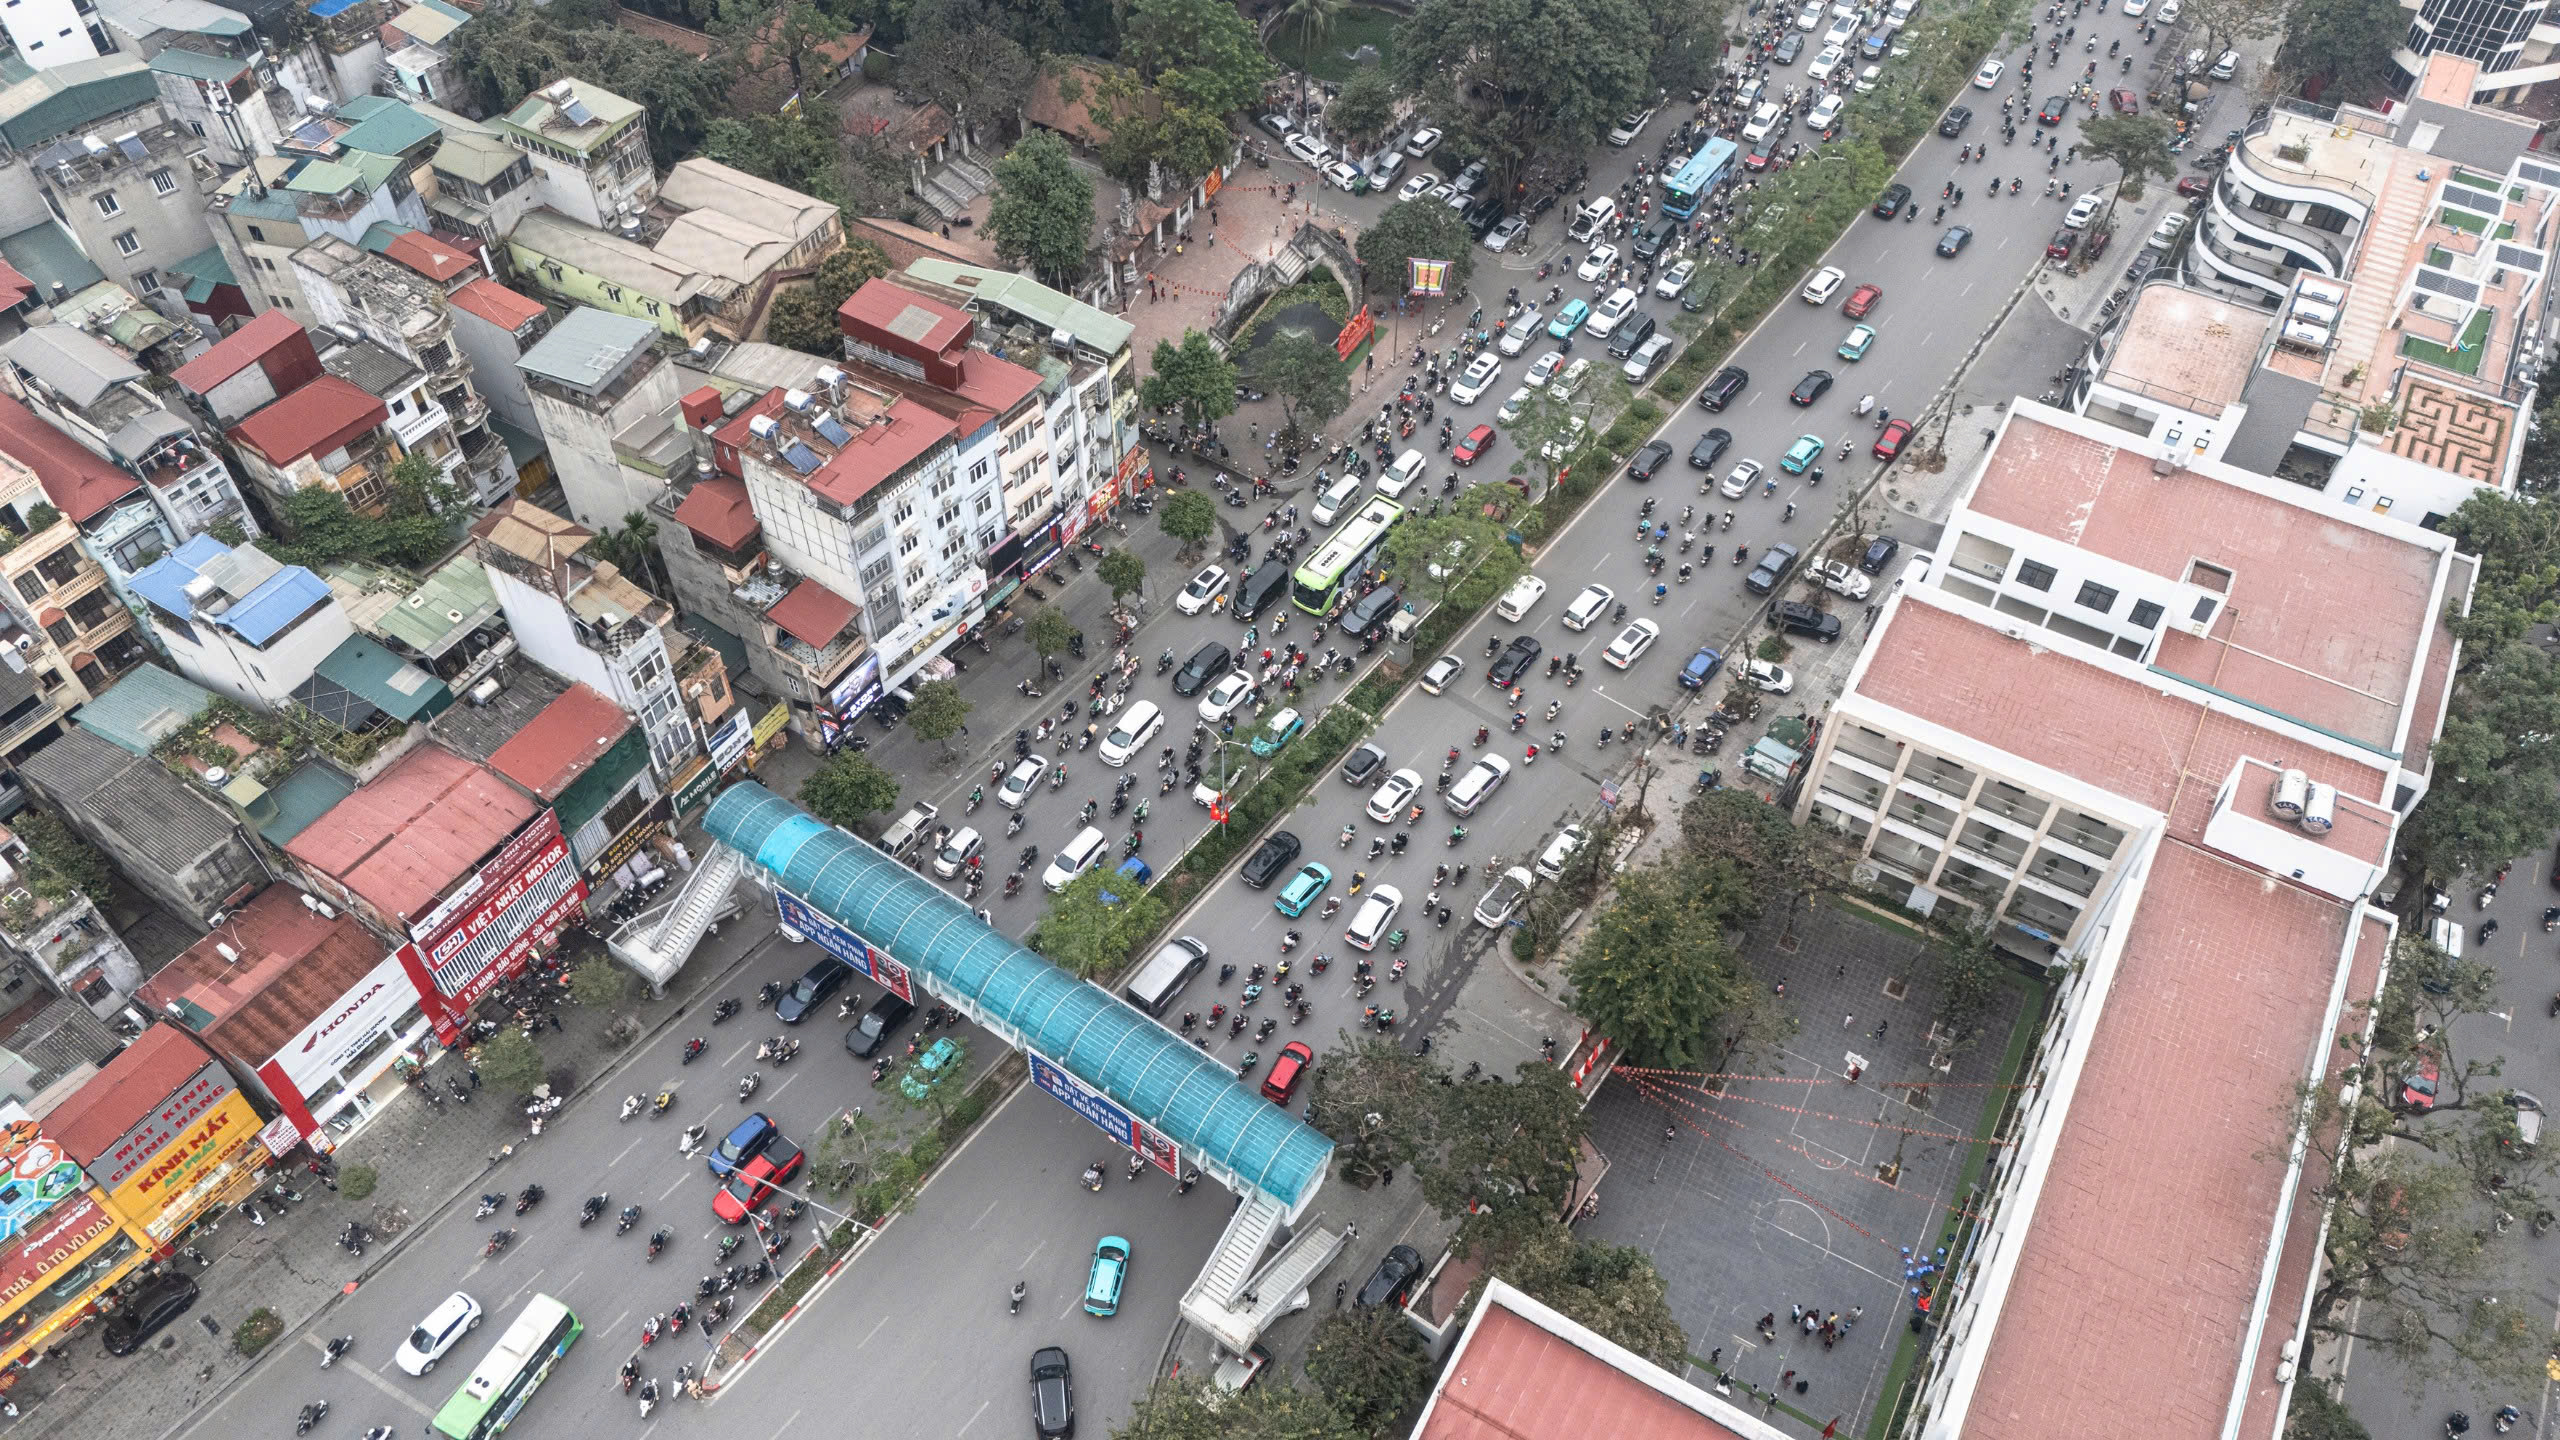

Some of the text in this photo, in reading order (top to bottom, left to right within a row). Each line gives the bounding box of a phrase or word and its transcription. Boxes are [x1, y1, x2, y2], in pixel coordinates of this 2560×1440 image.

[689, 770, 717, 798] MOBILE
[525, 817, 550, 841] MOTOR
[468, 908, 495, 934] VIỆT
[495, 882, 524, 913] NHẬT
[524, 845, 563, 885] MOTOR
[477, 968, 496, 989] HÀNH
[558, 903, 568, 917] XE
[567, 891, 580, 909] MÁY
[800, 921, 816, 936] APP
[320, 983, 386, 1038] HONDA
[1052, 1084, 1071, 1101] APP
[1072, 1098, 1099, 1121] NGÂN
[1101, 1117, 1128, 1140] HÀNG
[1090, 1101, 1107, 1115] XEM
[1108, 1112, 1127, 1129] PHIM
[136, 1147, 189, 1194] KÍNH
[23, 1202, 94, 1258] Pioneer
[36, 1261, 50, 1275] Ô
[47, 1248, 69, 1268] TÔ
